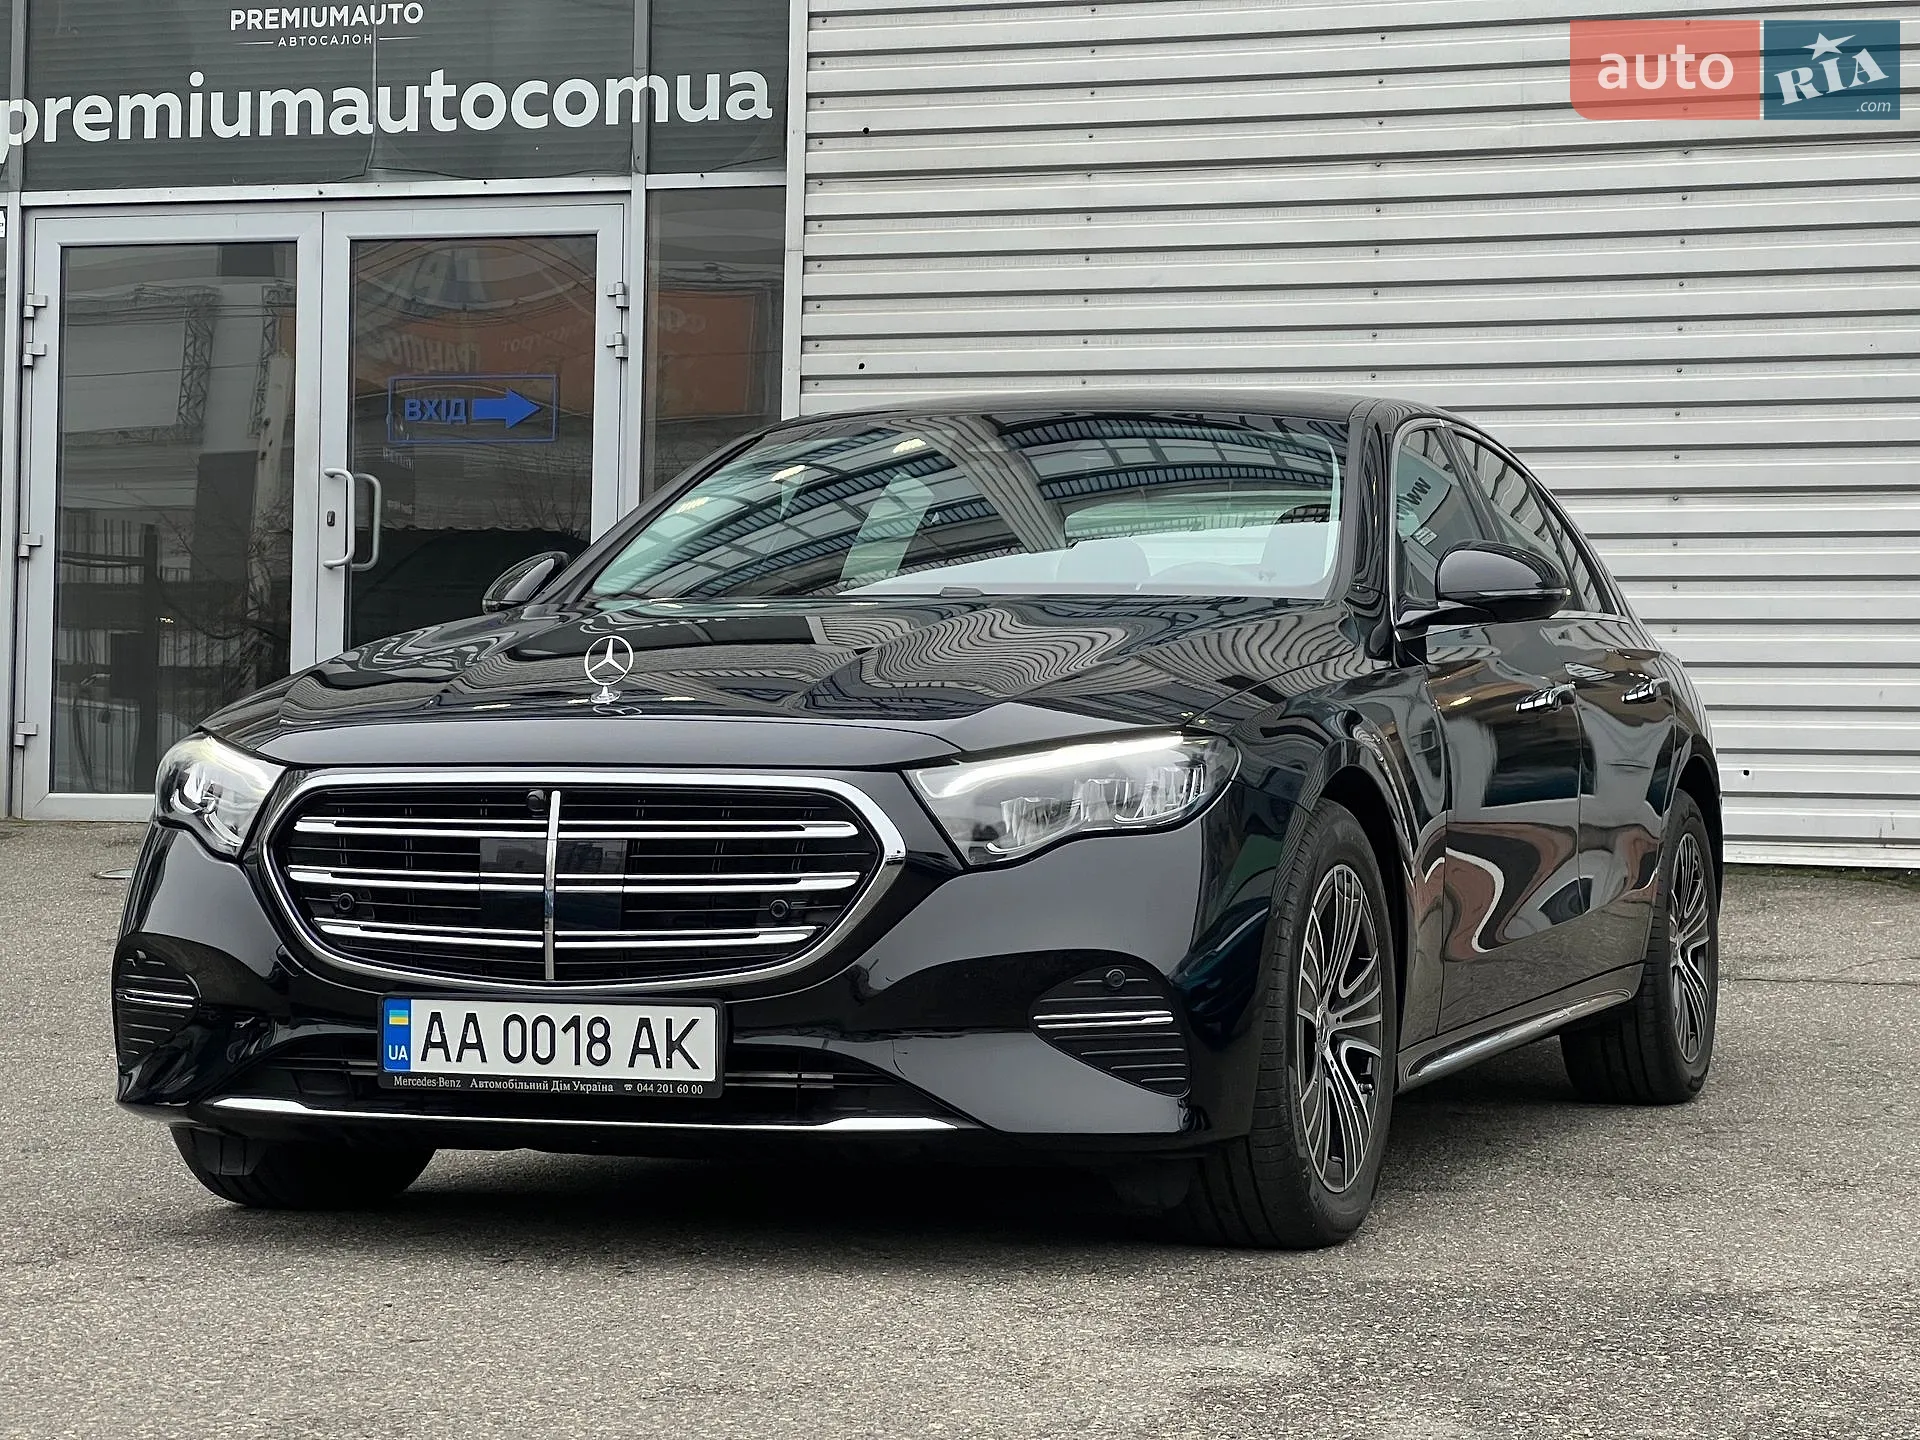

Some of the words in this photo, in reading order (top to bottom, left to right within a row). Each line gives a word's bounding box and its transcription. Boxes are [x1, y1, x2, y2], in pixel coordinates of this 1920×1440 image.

[230, 2, 424, 31] PREMIUMAUTO
[278, 34, 372, 47] АВТОСАЛОН
[404, 398, 467, 425] ВХІД
[420, 1011, 488, 1063] AA
[503, 1013, 612, 1067] 0018
[628, 1016, 701, 1070] AK
[388, 1044, 409, 1061] UA
[393, 1075, 462, 1088] Mercedes-Benz
[469, 1078, 549, 1090] Автомобільний
[550, 1080, 571, 1092] Дім
[573, 1080, 614, 1094] Україна
[636, 1083, 654, 1093] 044
[656, 1083, 674, 1094] 201
[676, 1084, 689, 1094] 60
[691, 1085, 704, 1095] 00
